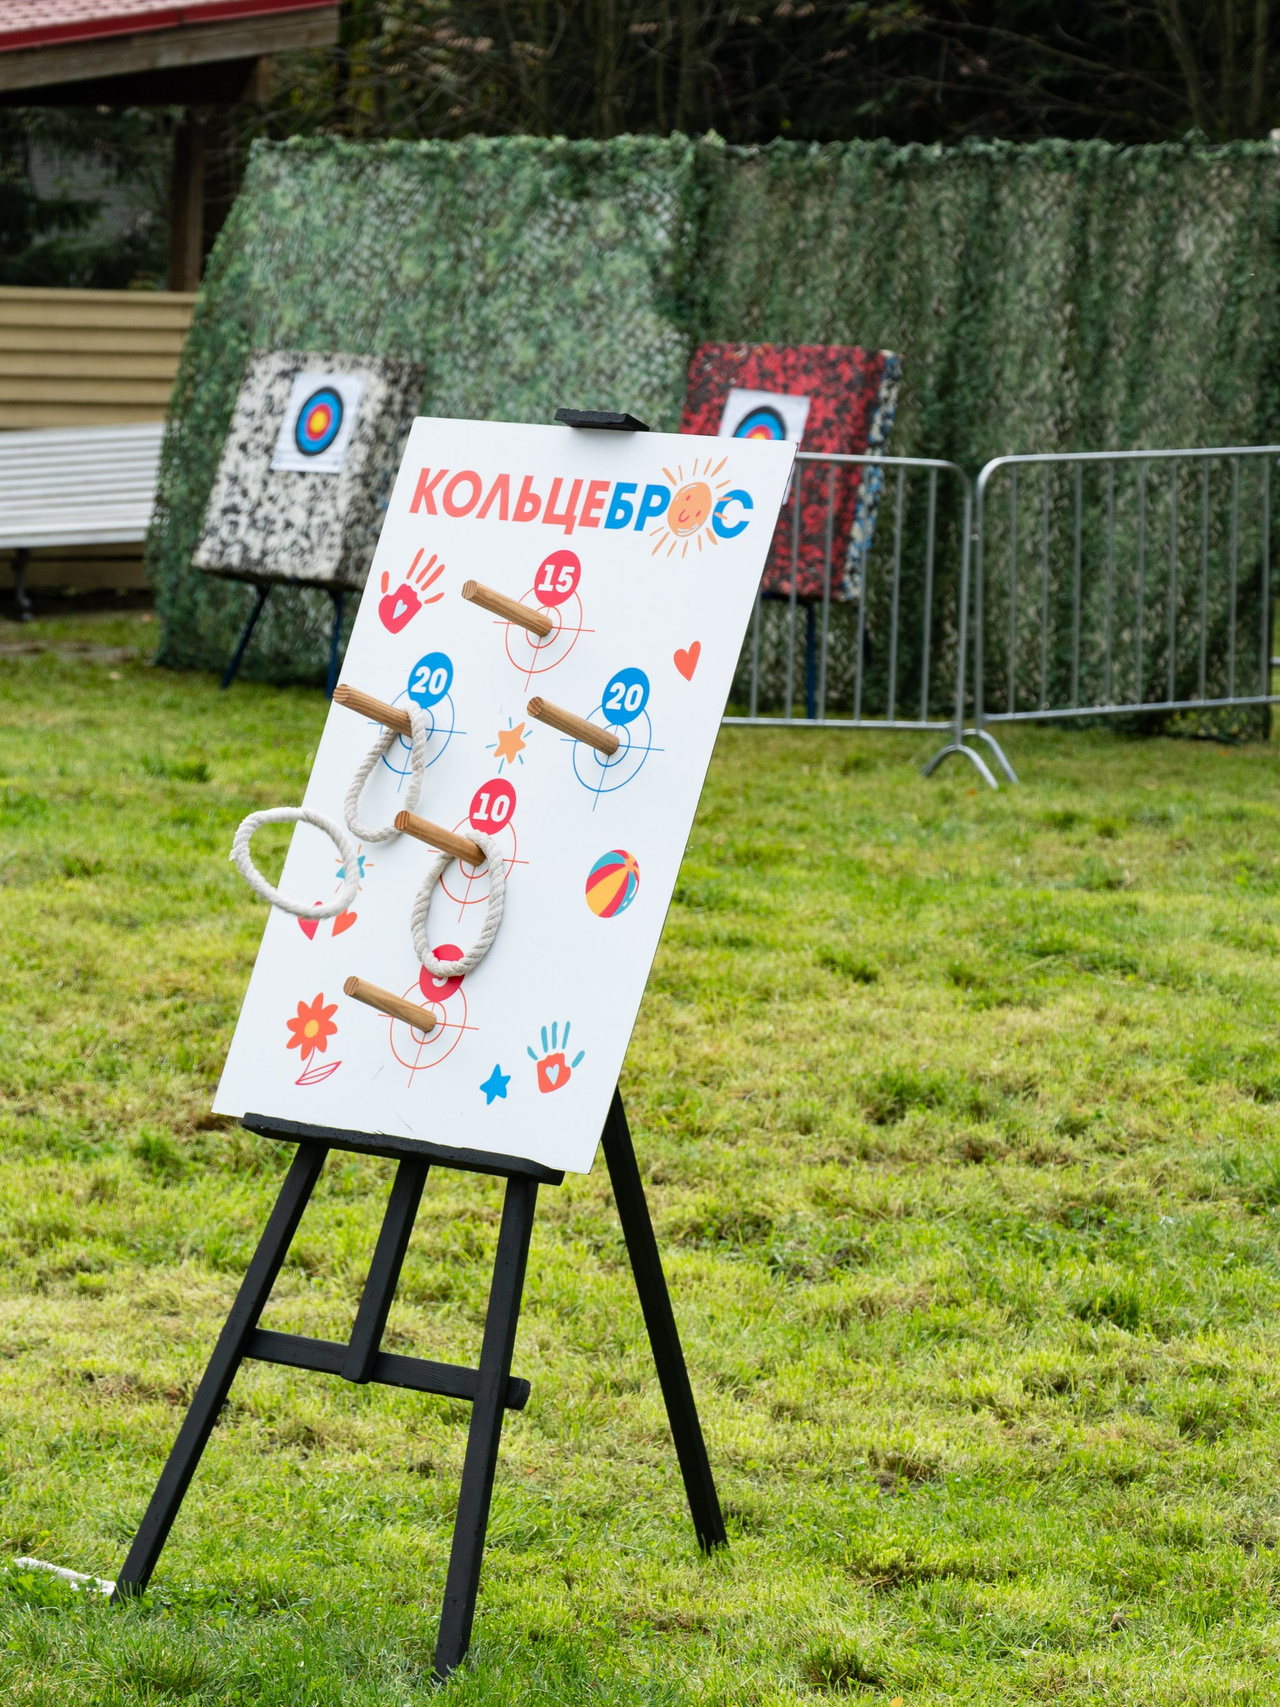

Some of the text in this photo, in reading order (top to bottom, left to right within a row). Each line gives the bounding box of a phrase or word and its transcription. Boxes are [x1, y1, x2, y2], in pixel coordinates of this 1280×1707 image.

[409, 467, 754, 539] КОЛЬЦЕБРОС
[537, 564, 574, 593] 15
[411, 666, 448, 695] 20
[605, 682, 644, 712] 20
[472, 793, 510, 822] 10
